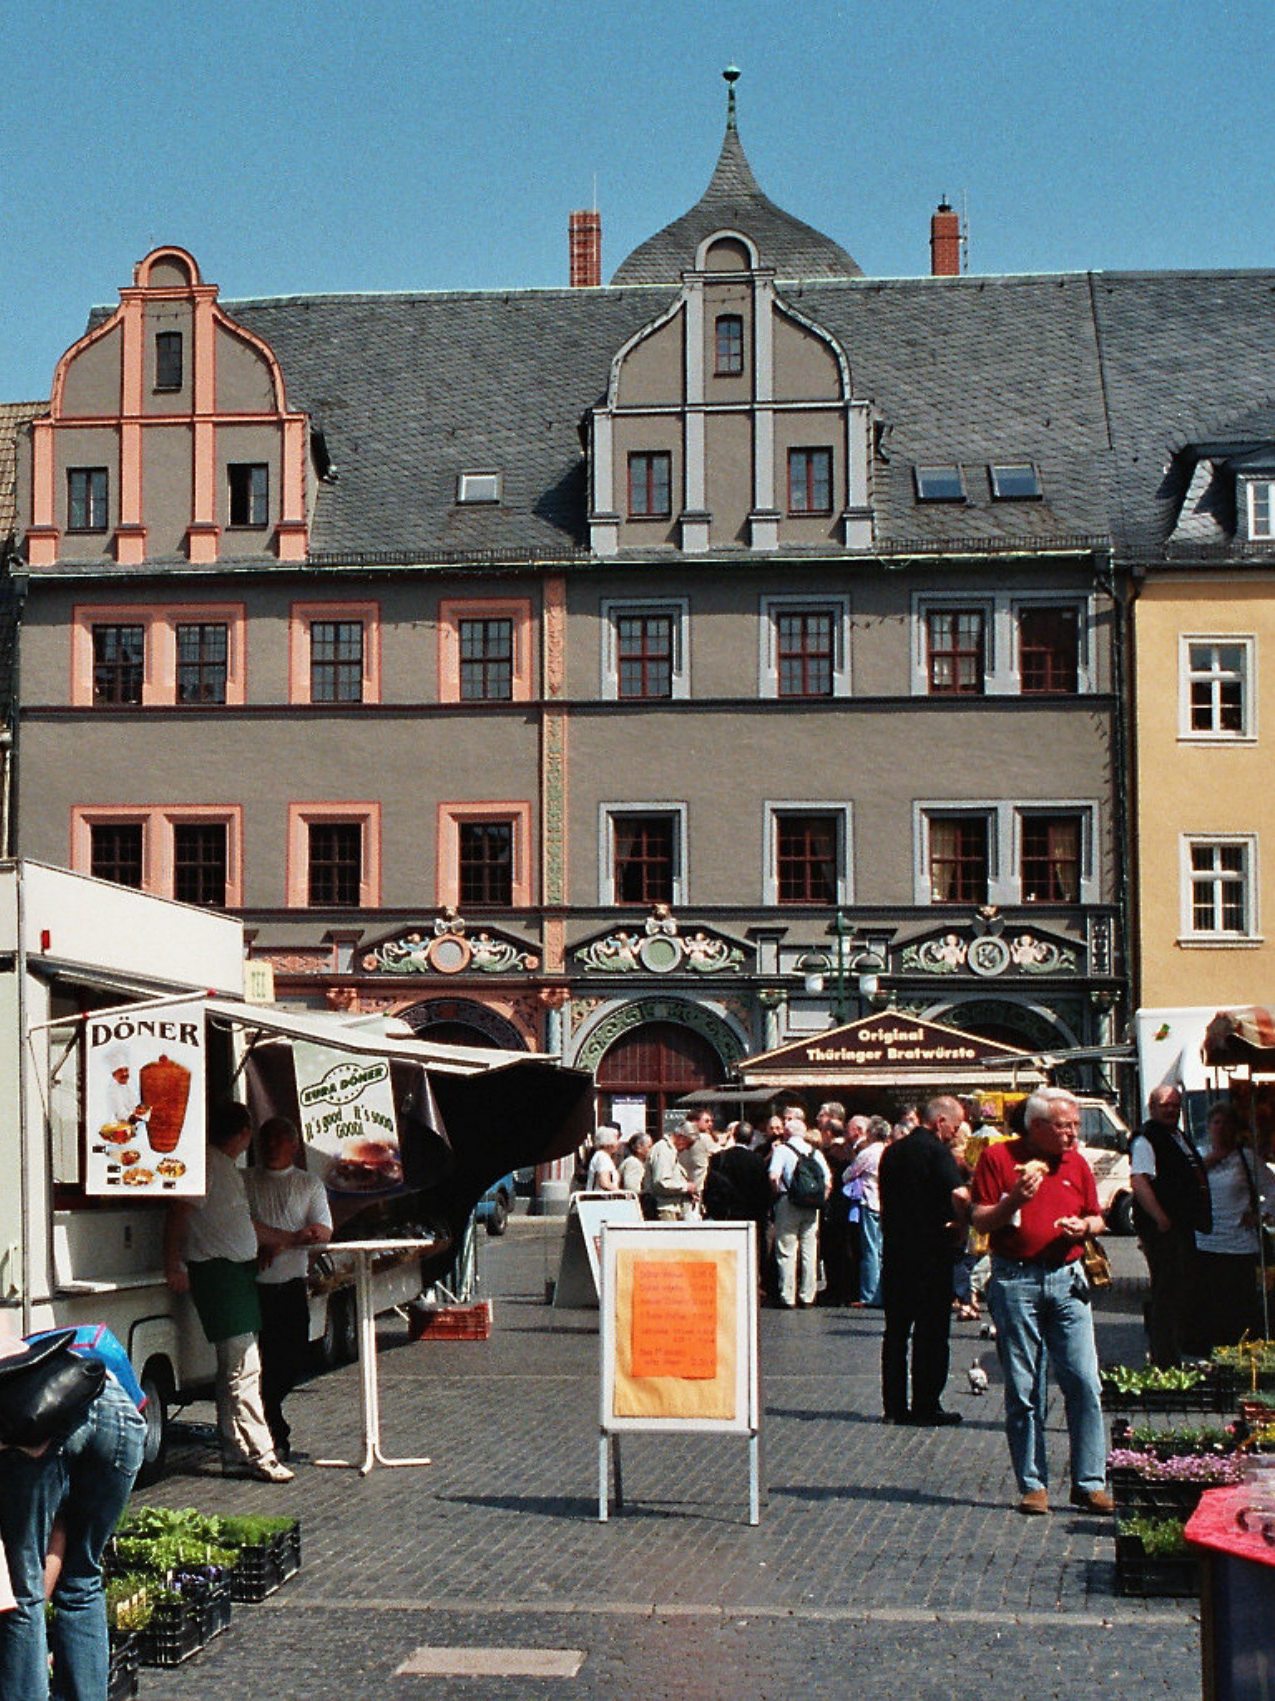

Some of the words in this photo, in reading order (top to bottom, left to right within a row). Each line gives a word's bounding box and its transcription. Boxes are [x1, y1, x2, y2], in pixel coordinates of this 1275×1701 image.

[92, 1016, 200, 1047] DÖNER
[858, 1028, 924, 1044] Original
[807, 1048, 882, 1062] Thüringer
[887, 1047, 975, 1060] Bratwürste
[339, 1066, 384, 1091] DÖNER
